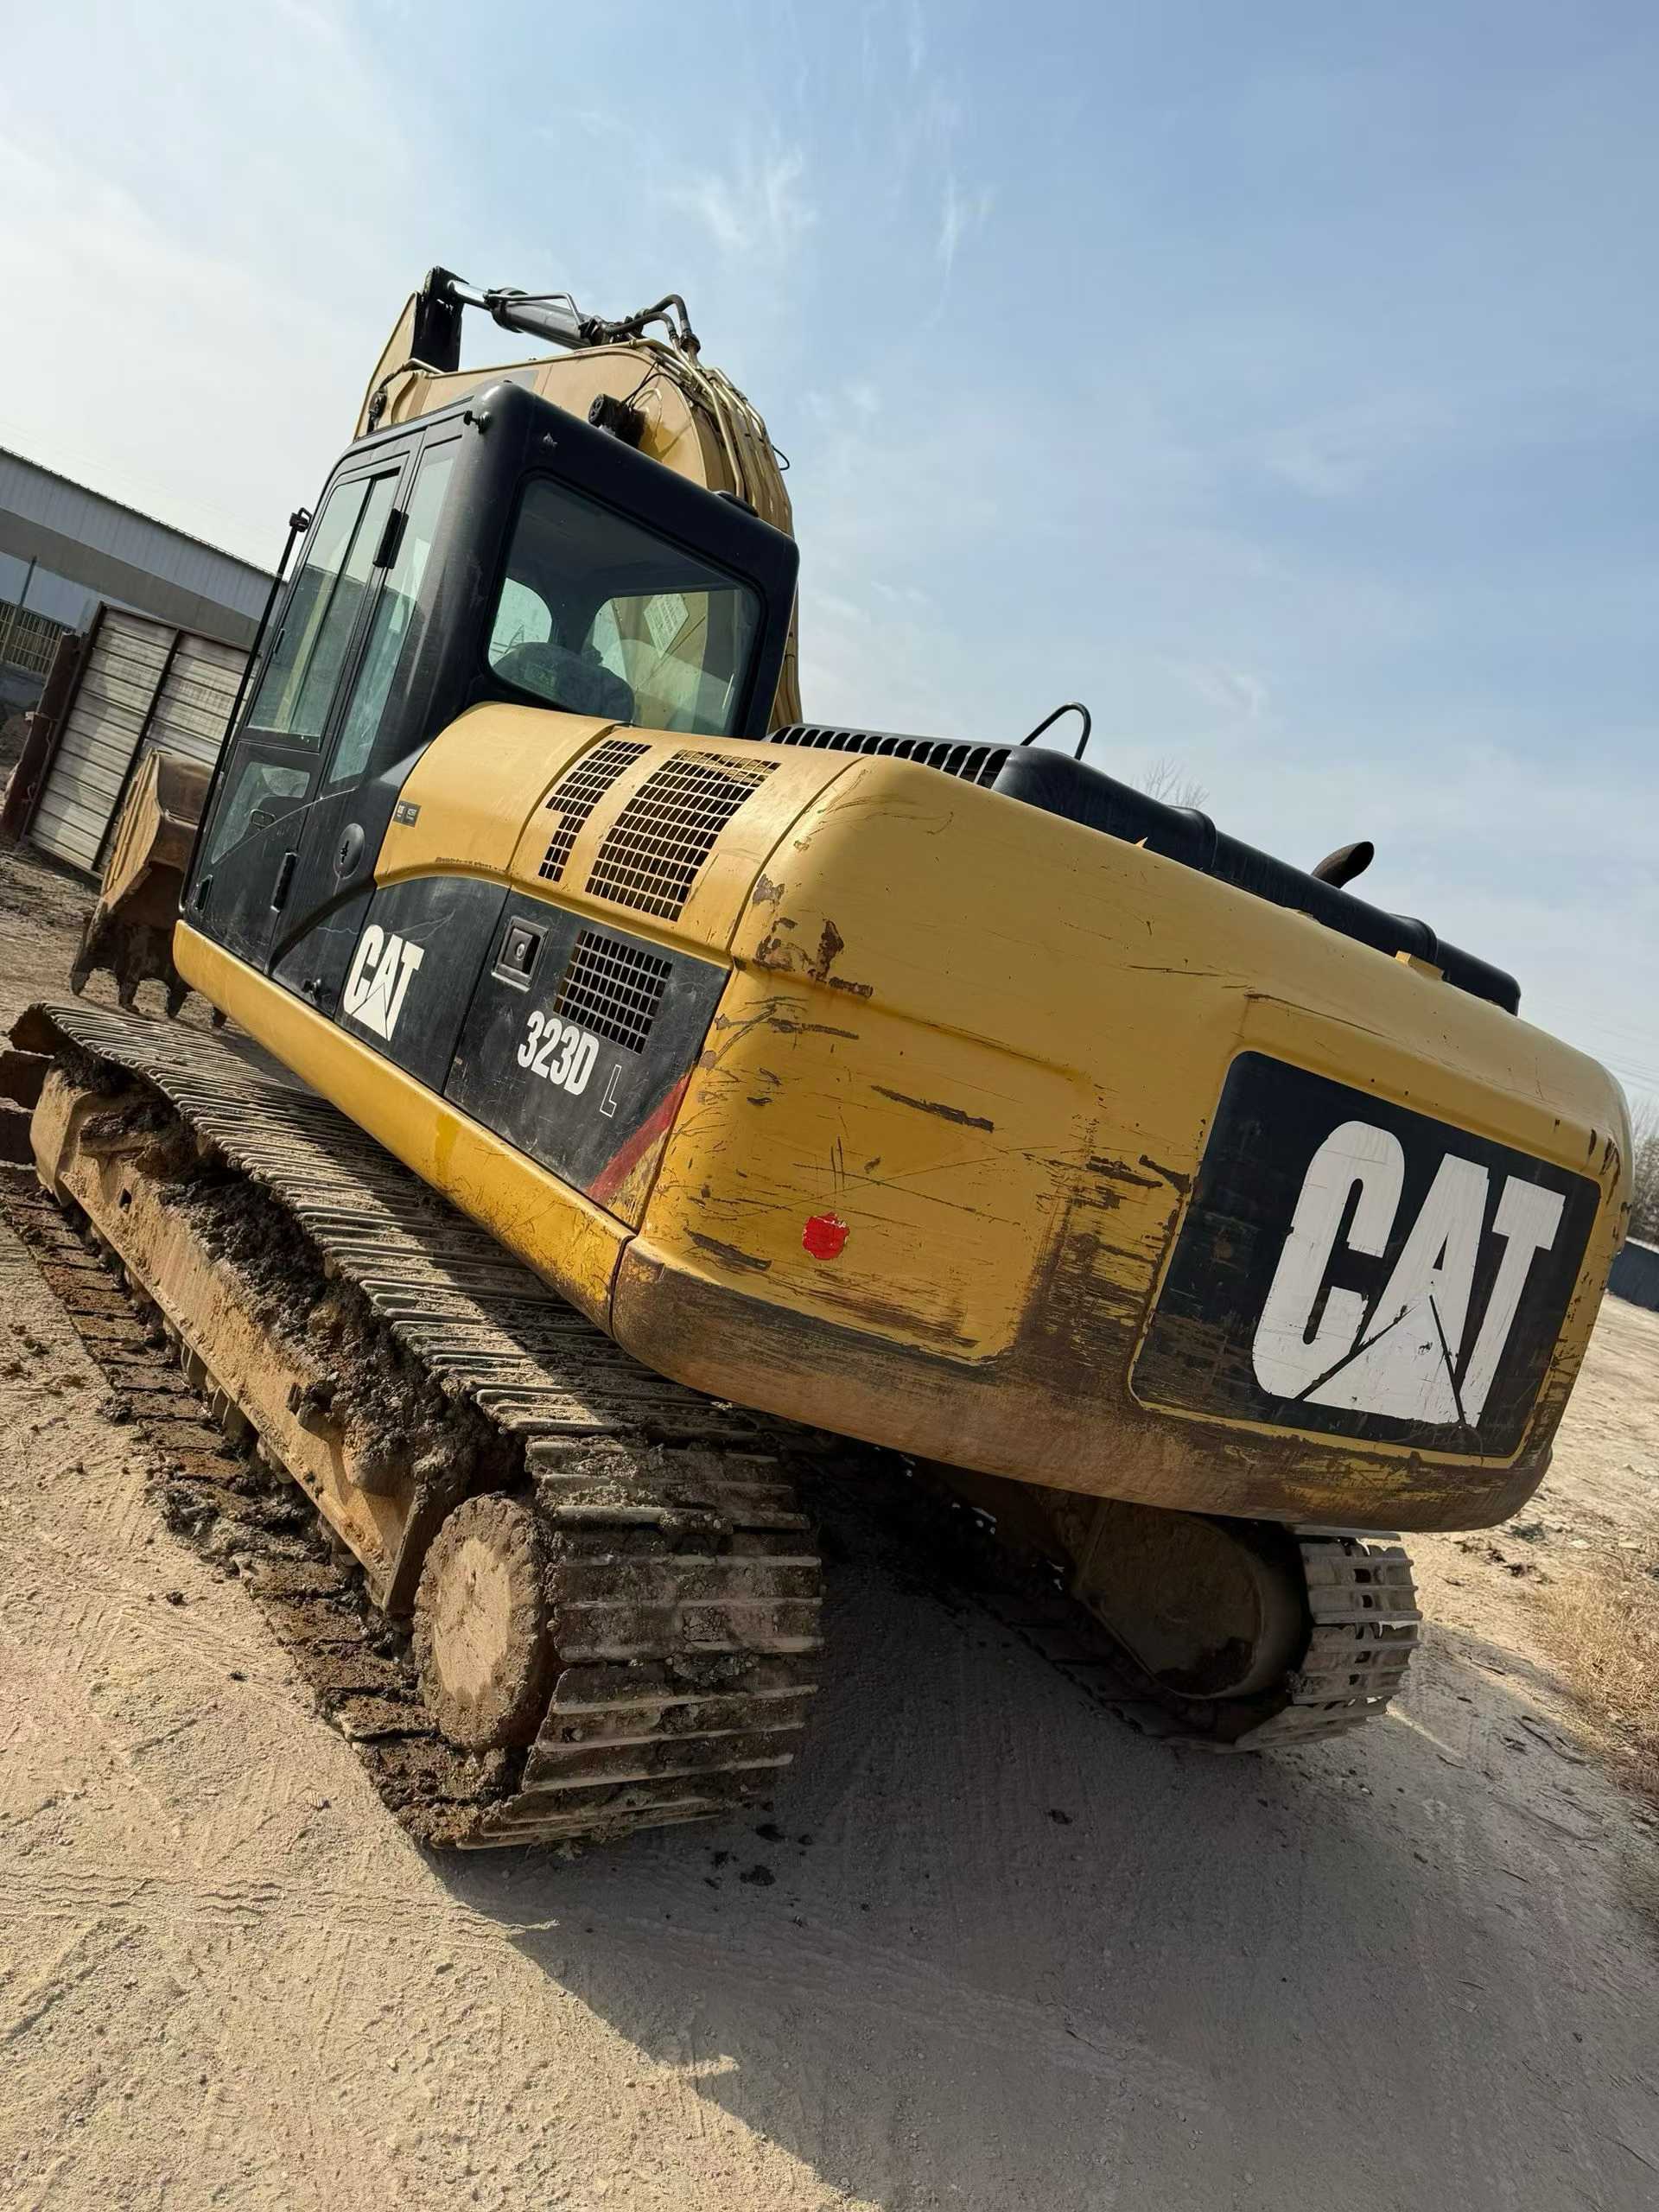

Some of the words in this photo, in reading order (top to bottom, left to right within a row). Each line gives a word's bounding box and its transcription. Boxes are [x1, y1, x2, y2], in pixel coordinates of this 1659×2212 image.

[343, 924, 425, 1041] CAT
[517, 1010, 600, 1096] 323D
[599, 1064, 622, 1118] L
[1252, 1120, 1567, 1428] CAT
